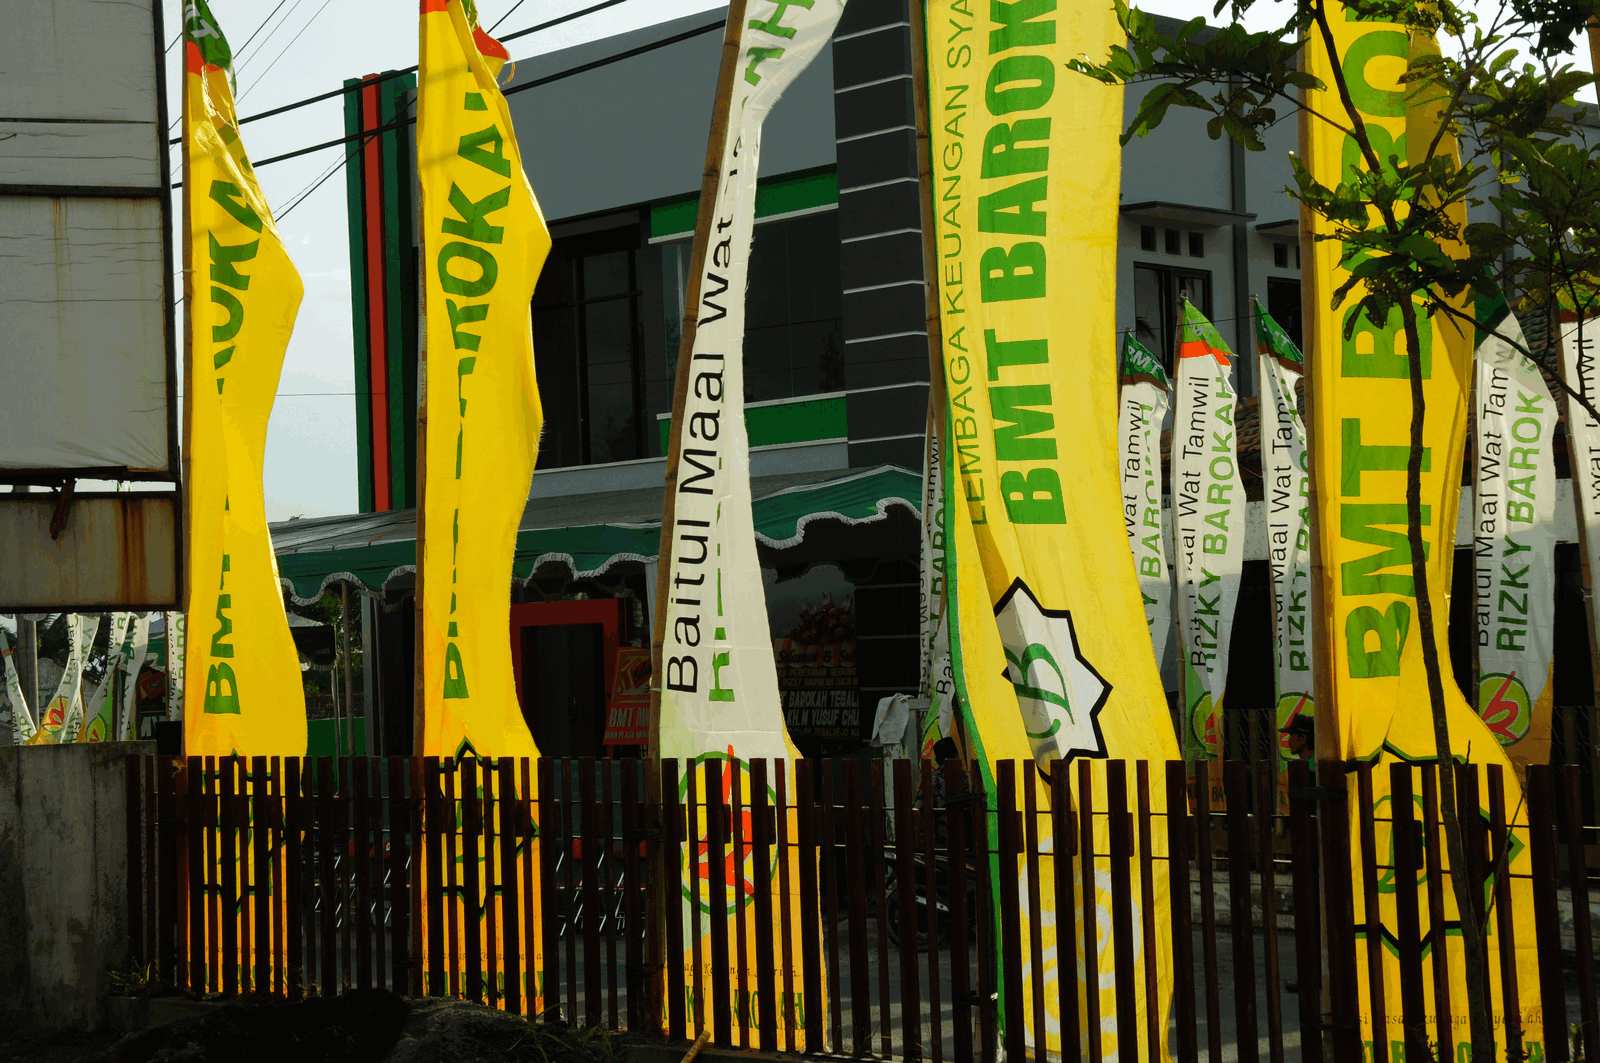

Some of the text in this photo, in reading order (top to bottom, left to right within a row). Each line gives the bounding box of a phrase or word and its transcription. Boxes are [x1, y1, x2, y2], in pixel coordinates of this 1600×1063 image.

[943, 85, 969, 314] KEUANGAN
[697, 214, 733, 328] Wat
[978, 0, 1067, 525] BMT BAROK
[678, 353, 725, 495] Maal
[948, 326, 987, 524] LEMBAGA
[1124, 400, 1143, 482] Tamwil
[1182, 376, 1210, 460] Tamwil
[1480, 431, 1502, 482] Wat
[1178, 471, 1201, 517] Wat
[1203, 376, 1234, 555] BAROKAH
[1271, 465, 1292, 513] Wat
[1270, 524, 1288, 584] Maal
[1341, 418, 1432, 679] BMT
[1475, 494, 1498, 557] Maal
[1496, 389, 1545, 652] RIZKY BAROK
[666, 519, 710, 693] Baitul
[1476, 568, 1492, 647] Baitul
[608, 708, 635, 728] BMT
[788, 690, 828, 708] BAROKAH
[811, 709, 840, 727] YUSUF
